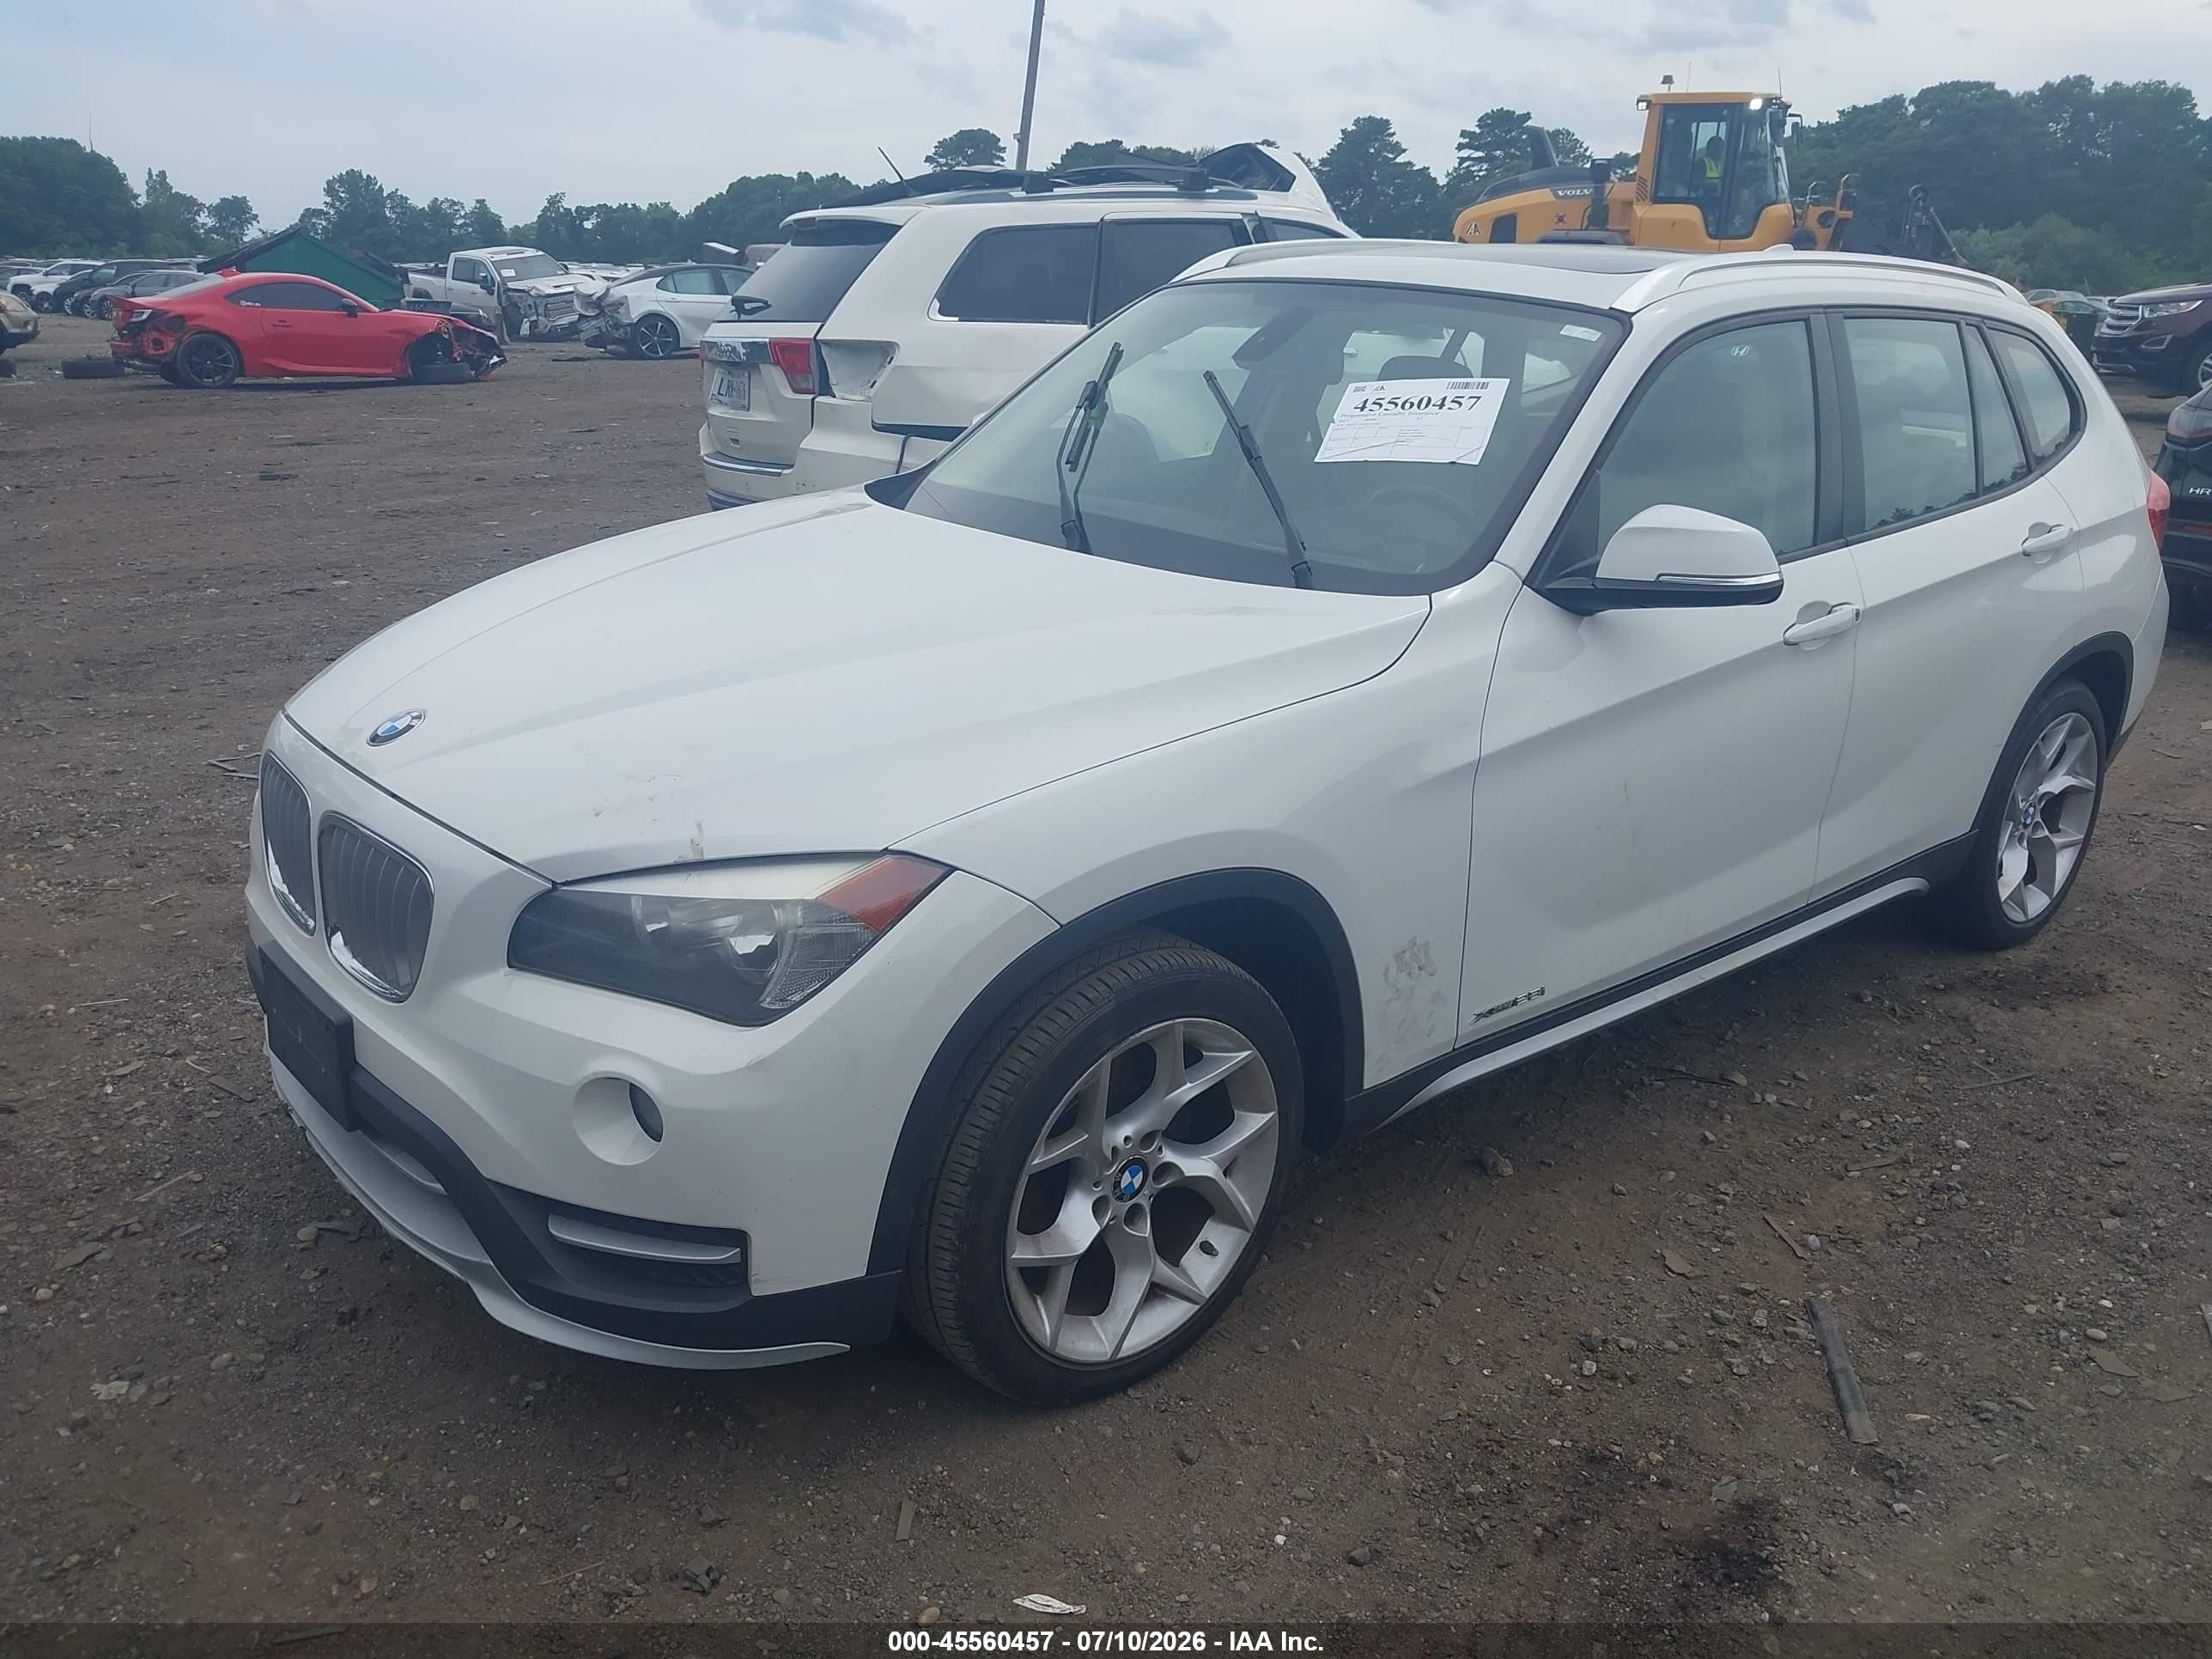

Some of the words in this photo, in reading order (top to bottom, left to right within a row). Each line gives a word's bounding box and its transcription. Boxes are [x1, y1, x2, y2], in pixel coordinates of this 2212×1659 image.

[1556, 188, 1595, 197] VOLV
[1352, 394, 1482, 413] 45560457
[2189, 487, 2212, 495] HR
